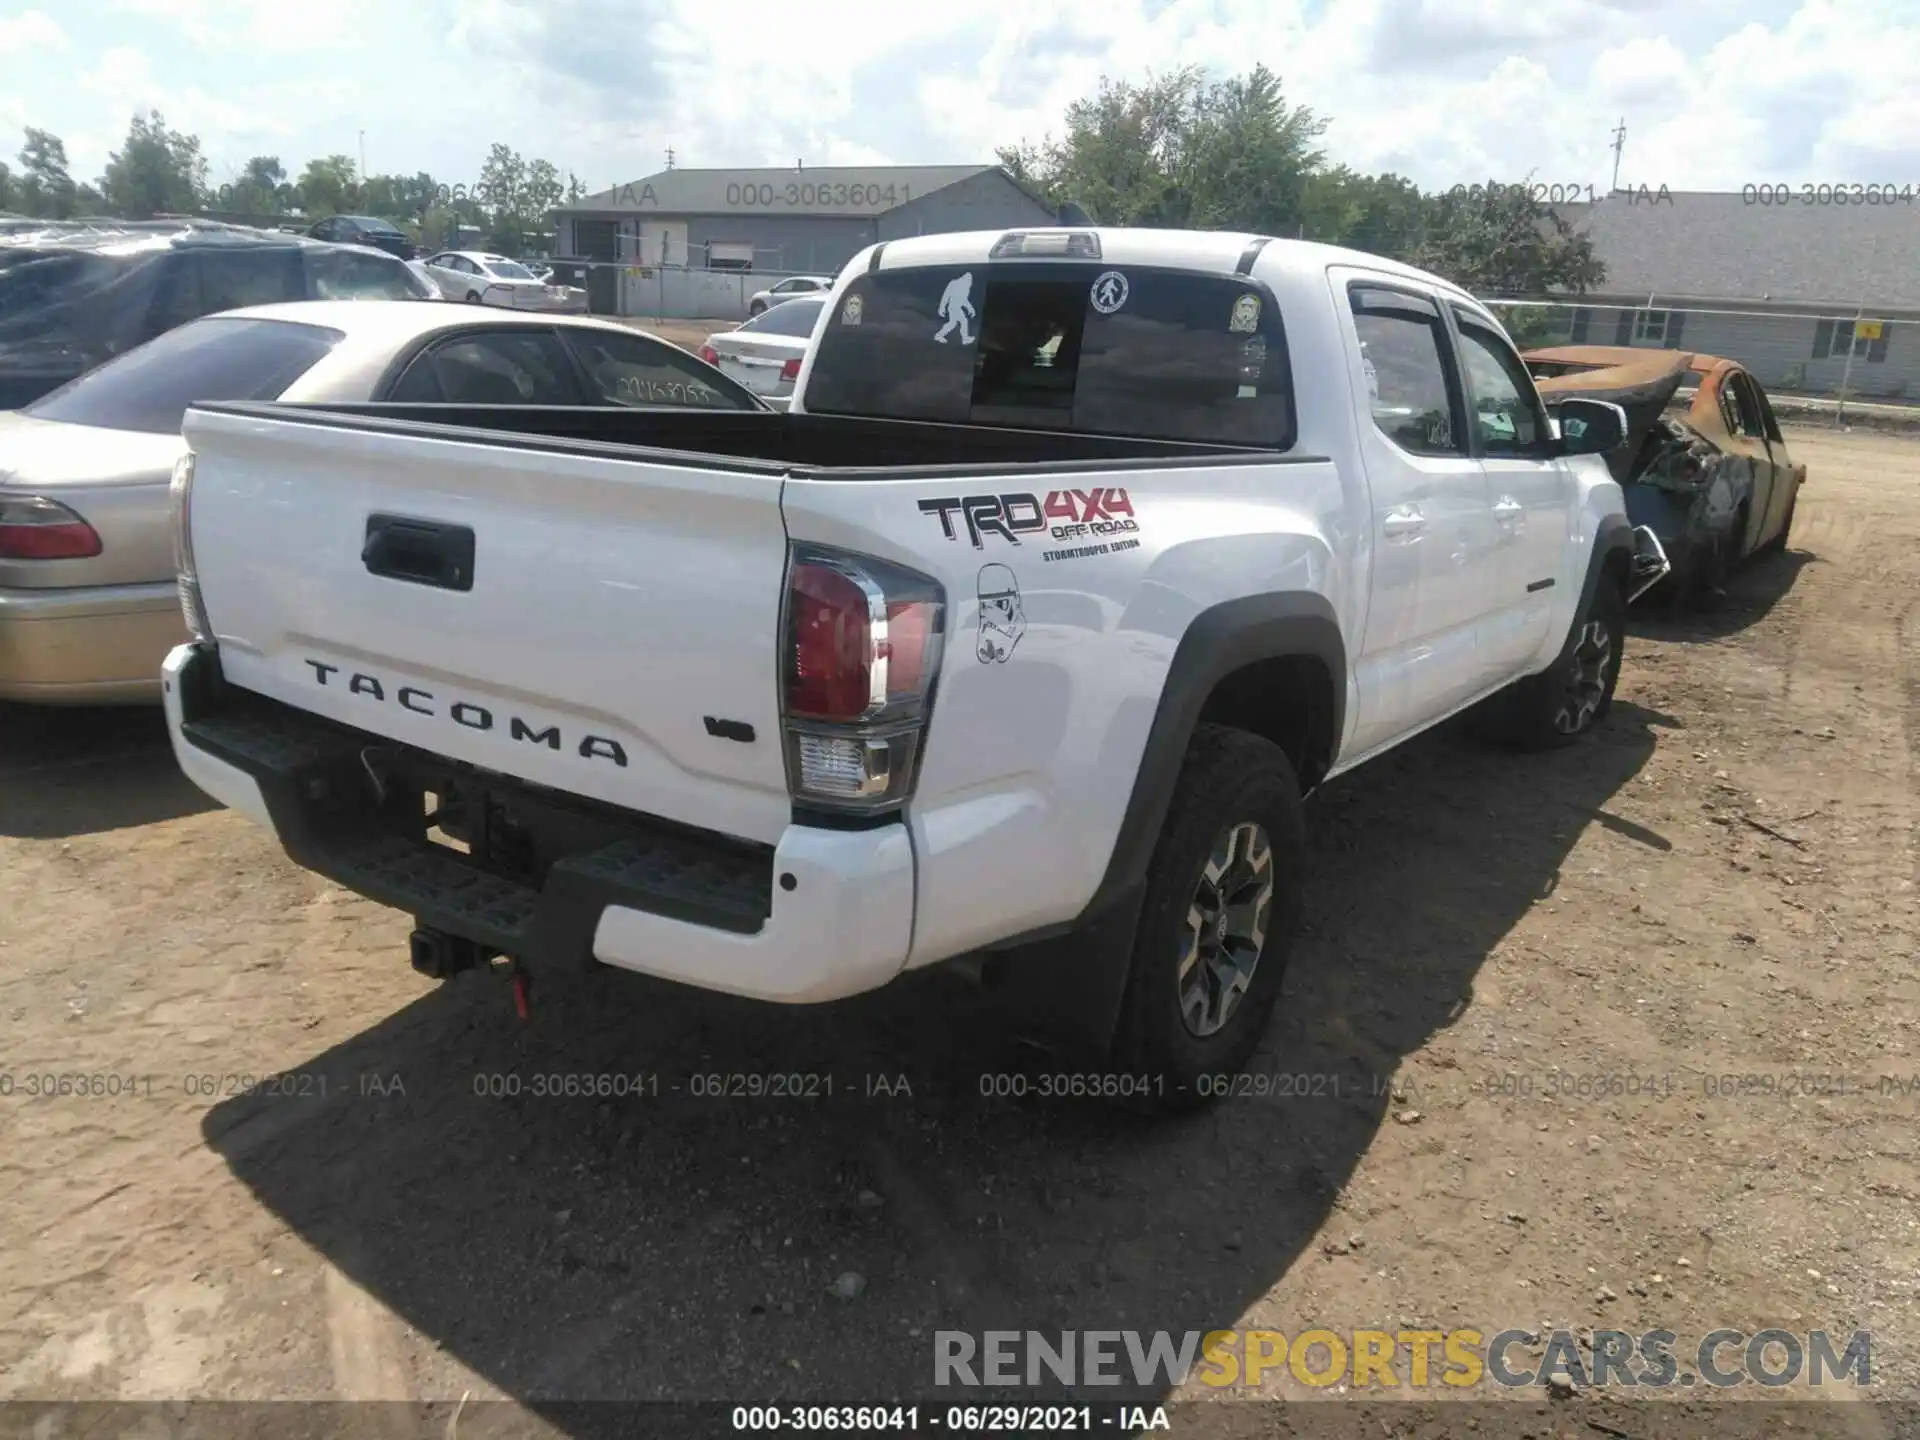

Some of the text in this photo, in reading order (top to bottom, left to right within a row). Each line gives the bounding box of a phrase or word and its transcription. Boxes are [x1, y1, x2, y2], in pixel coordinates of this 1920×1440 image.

[917, 487, 1135, 551] TRD 4X4
[1051, 518, 1141, 541] OFF ROAD
[1042, 538, 1140, 562] STORMTROOPER EDITION
[304, 659, 628, 767] TACOMA
